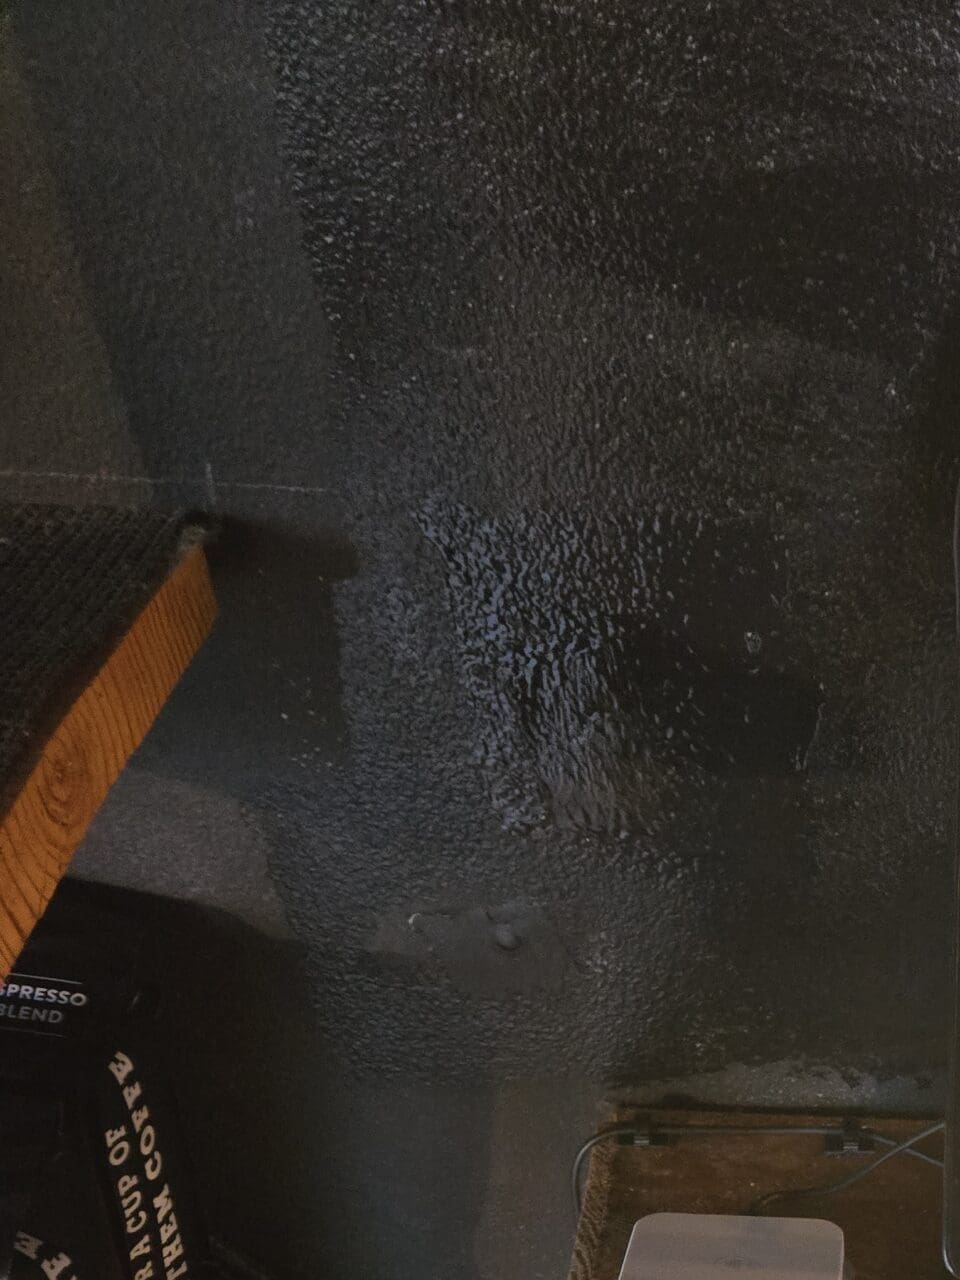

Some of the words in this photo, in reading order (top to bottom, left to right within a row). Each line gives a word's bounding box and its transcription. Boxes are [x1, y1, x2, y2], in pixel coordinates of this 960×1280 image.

[104, 1125, 131, 1166] OF
[117, 1174, 148, 1234] CUP
[129, 1234, 152, 1260] A
